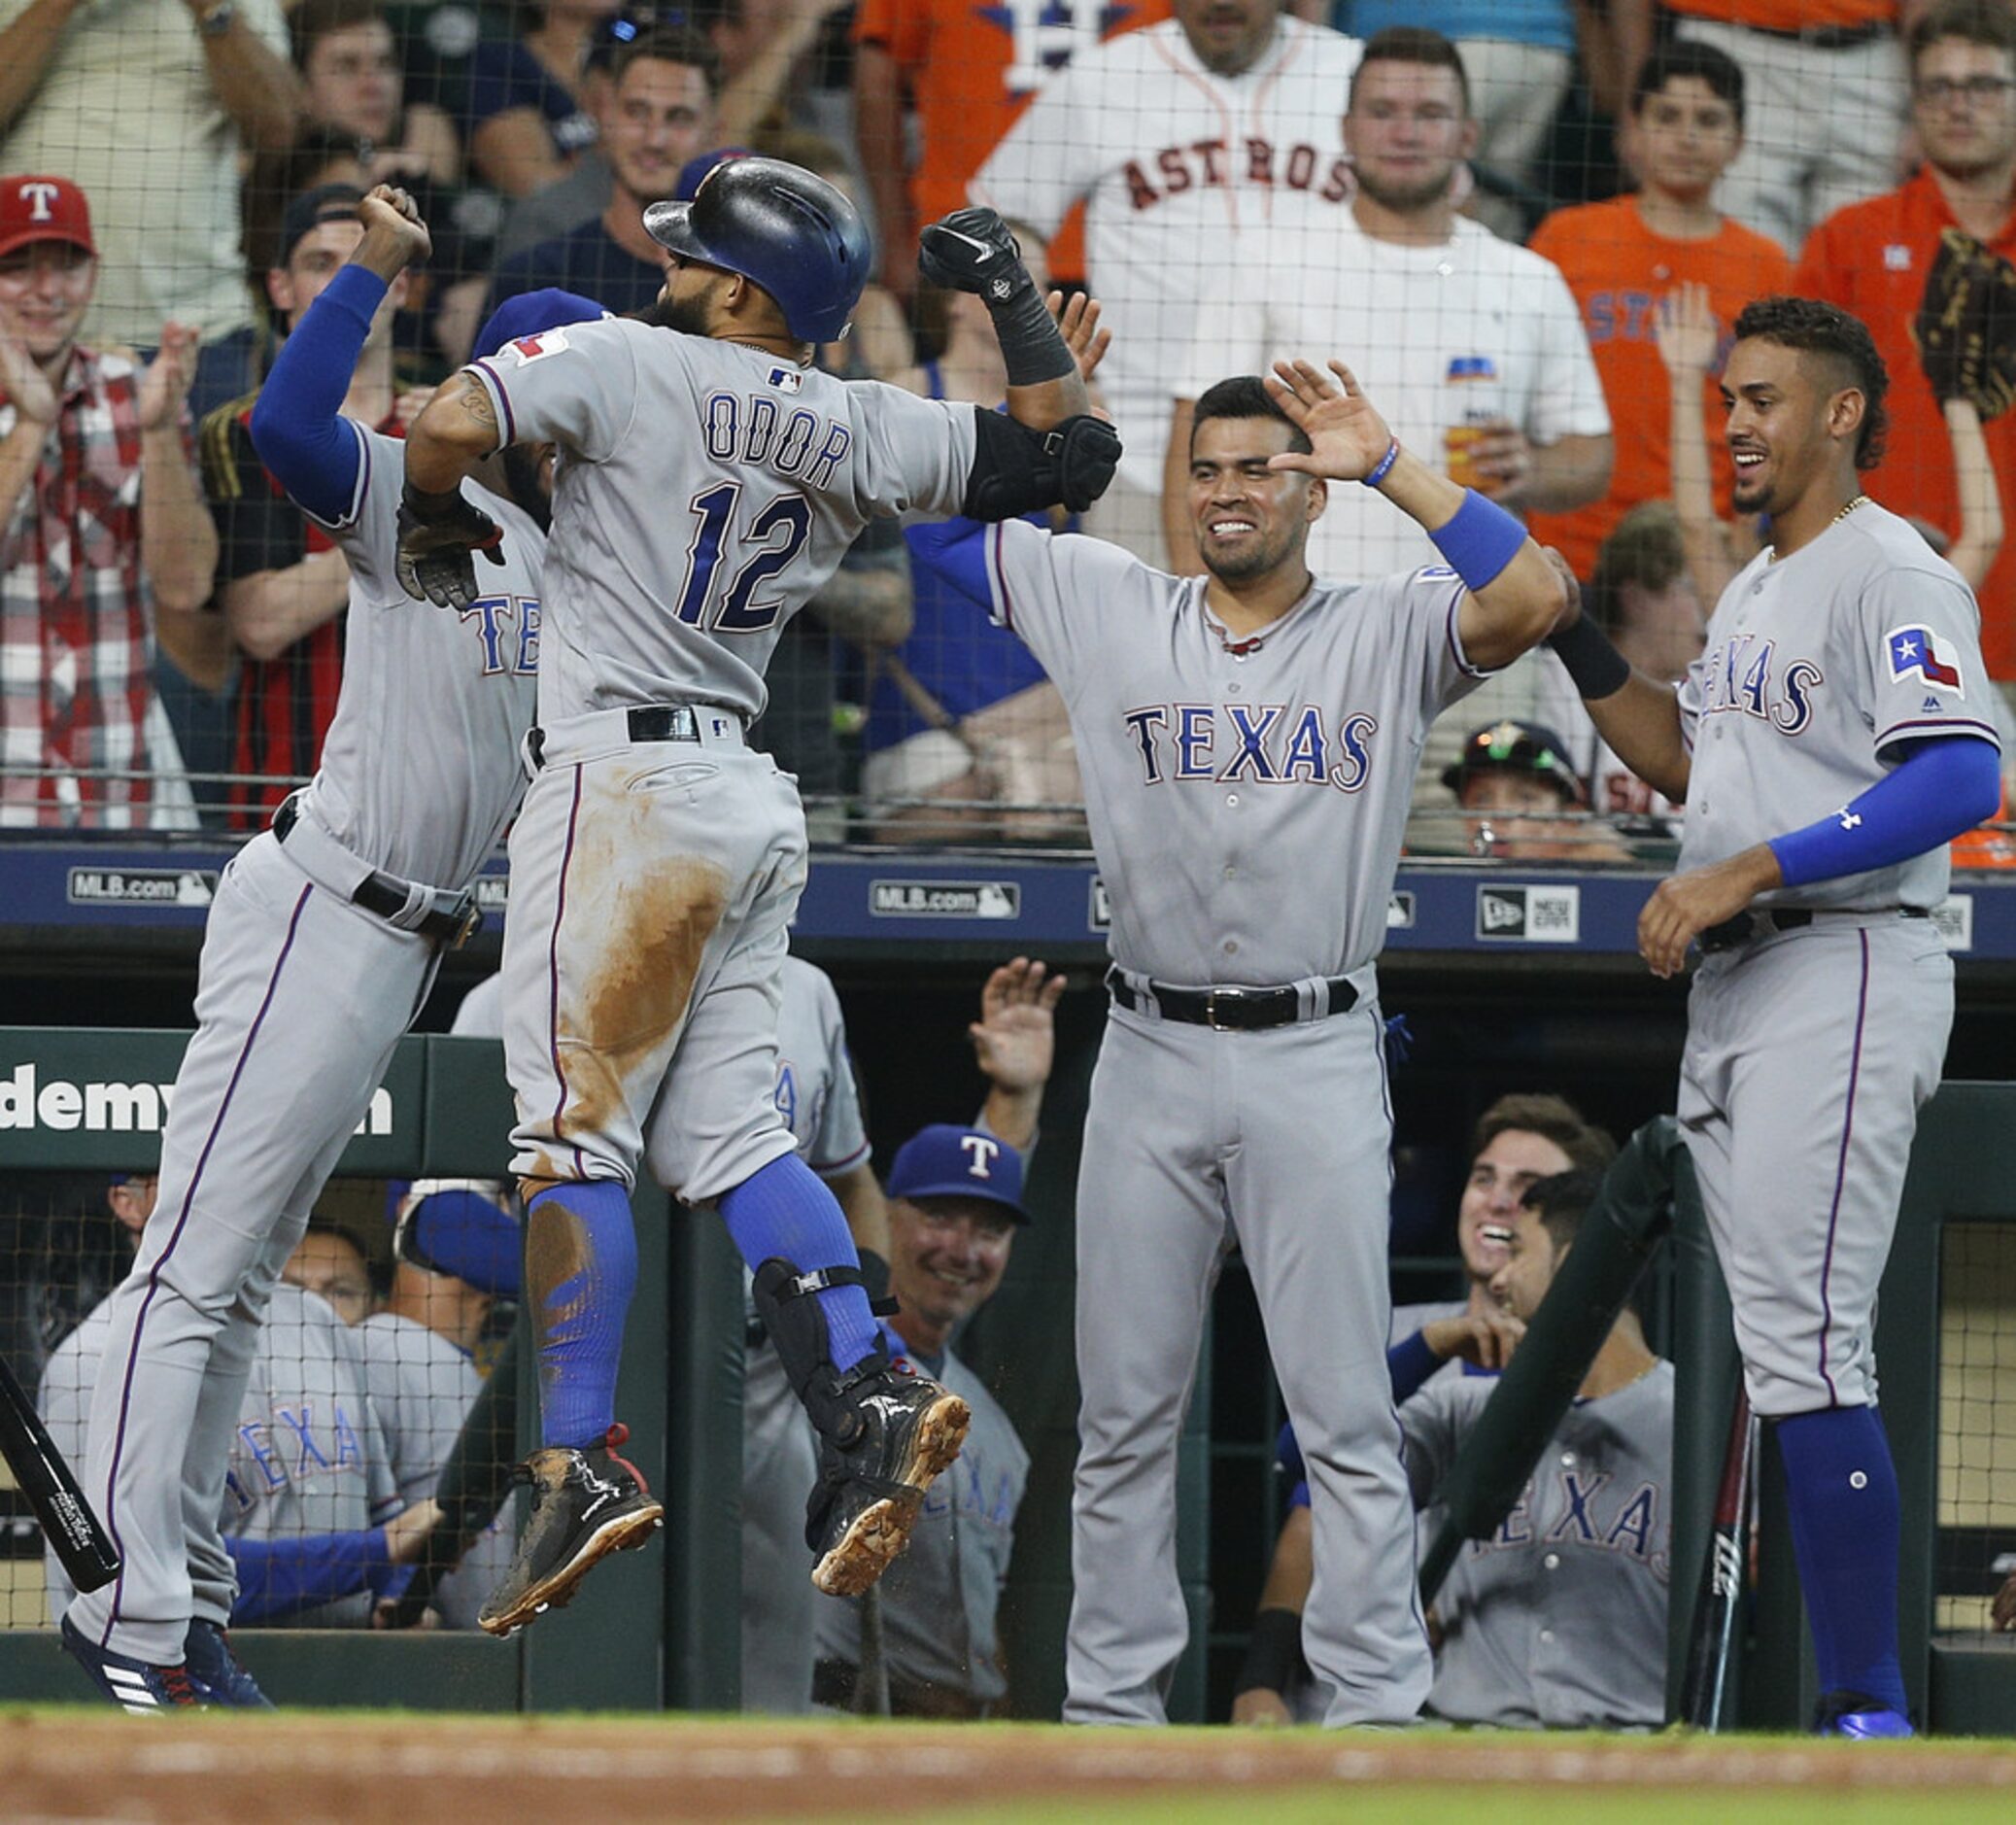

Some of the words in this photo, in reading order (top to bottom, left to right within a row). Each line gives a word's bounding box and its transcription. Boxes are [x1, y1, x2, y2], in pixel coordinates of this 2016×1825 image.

[19, 182, 59, 222] T
[1122, 137, 1359, 211] ASTROS
[703, 390, 851, 491] ODOR
[673, 480, 814, 634] 12
[1123, 704, 1379, 793] TEXAS
[75, 874, 176, 898] MLB.com
[877, 887, 976, 911] MLB.com
[960, 1135, 999, 1178] T
[1459, 1470, 1669, 1584] EXA
